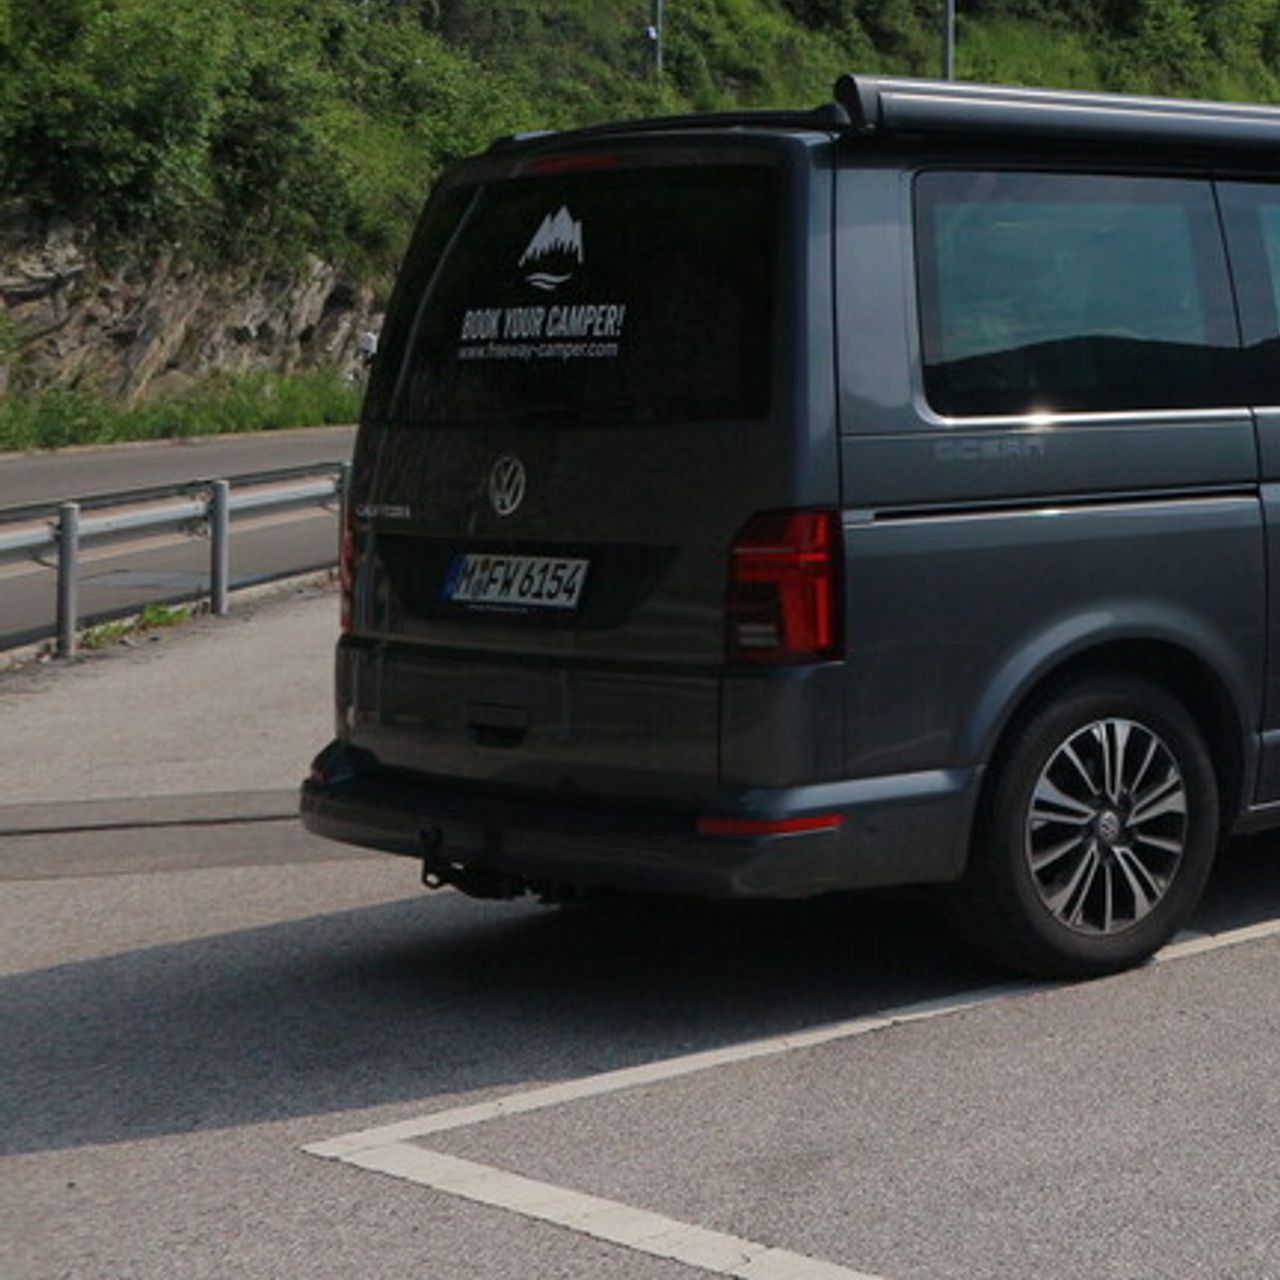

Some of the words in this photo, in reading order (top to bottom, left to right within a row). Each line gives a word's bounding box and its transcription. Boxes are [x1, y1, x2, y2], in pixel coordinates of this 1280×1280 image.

[461, 308, 501, 339] BOOK
[503, 306, 546, 339] YOUR
[545, 304, 626, 337] CAMPER!
[518, 560, 581, 601] 6154
